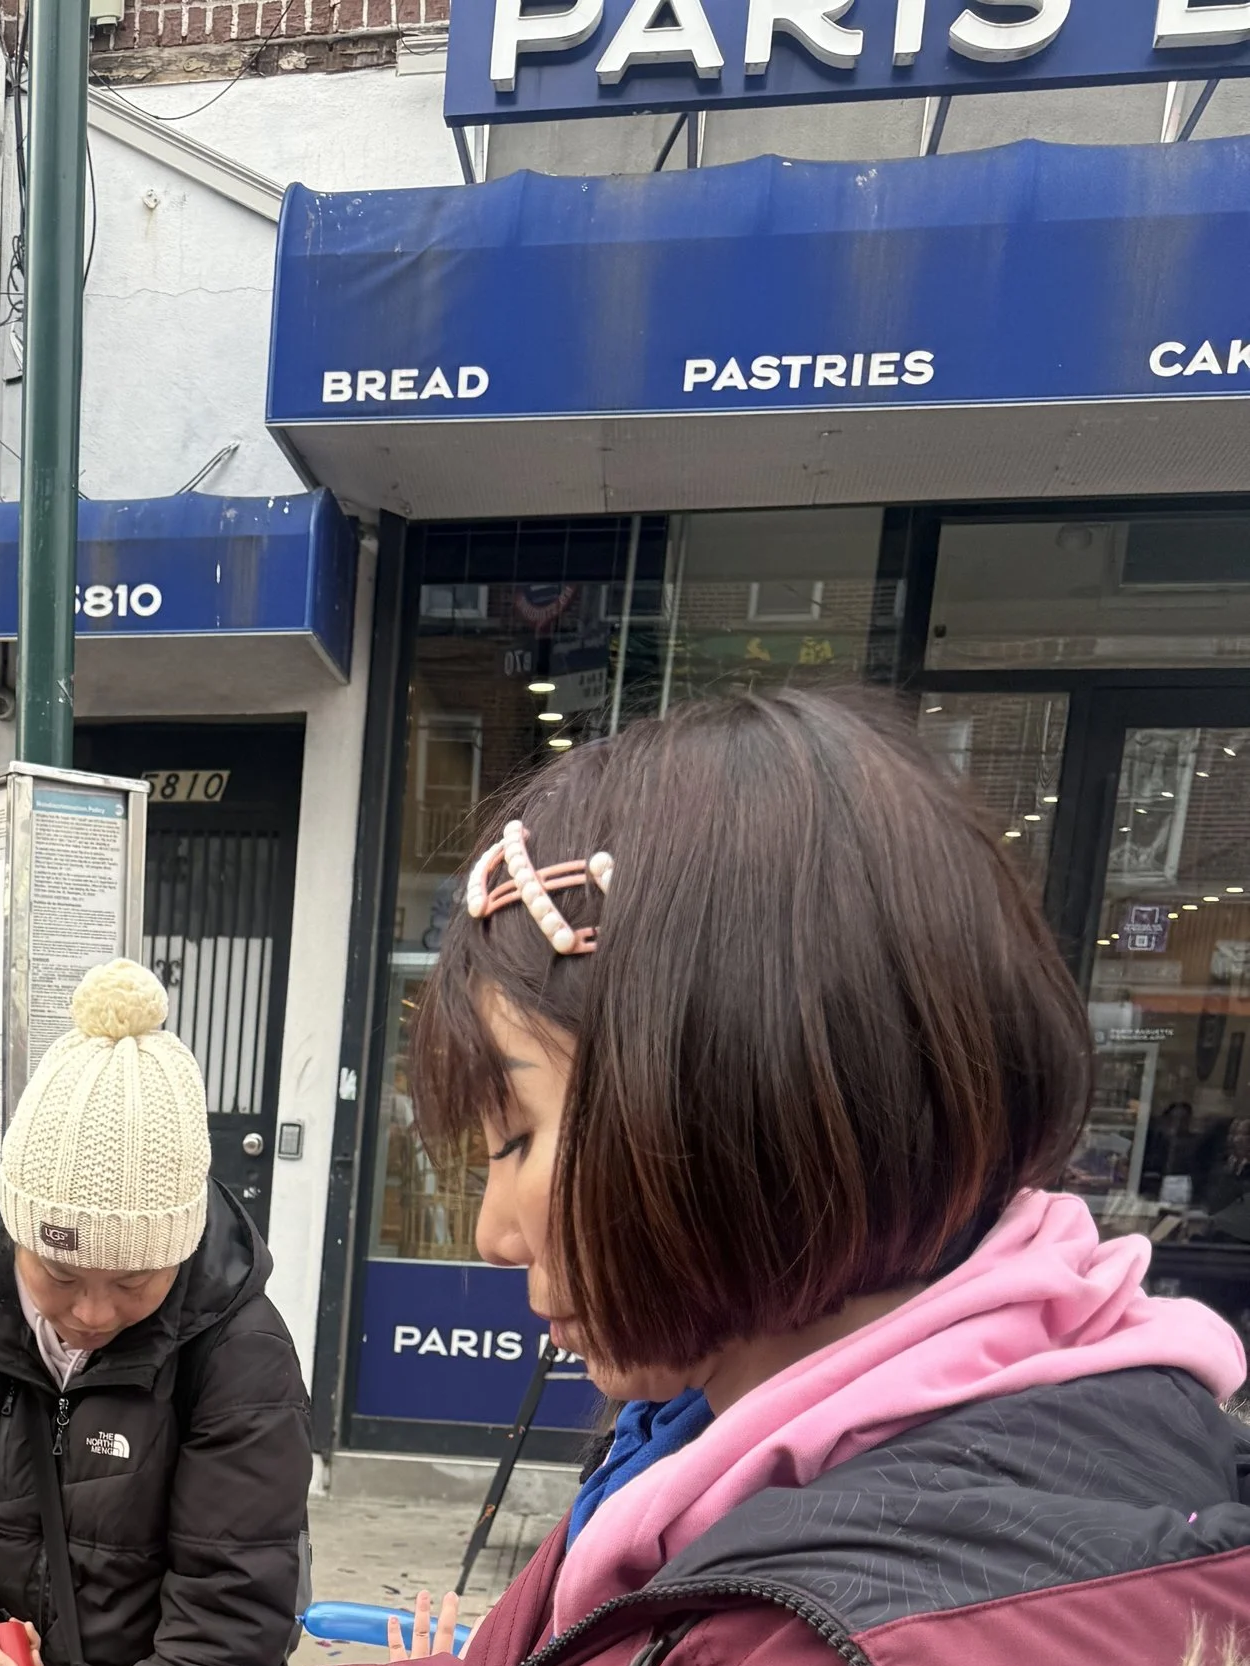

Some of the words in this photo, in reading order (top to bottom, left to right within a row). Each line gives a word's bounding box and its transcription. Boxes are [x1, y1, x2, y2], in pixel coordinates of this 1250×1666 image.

[321, 366, 489, 403] BREAD
[683, 350, 935, 392] PASTRIES
[75, 583, 162, 617] 810
[44, 1227, 66, 1240] UGG
[393, 1325, 523, 1361] PARIS
[85, 1437, 114, 1447] NORTH
[98, 1431, 114, 1441] THE
